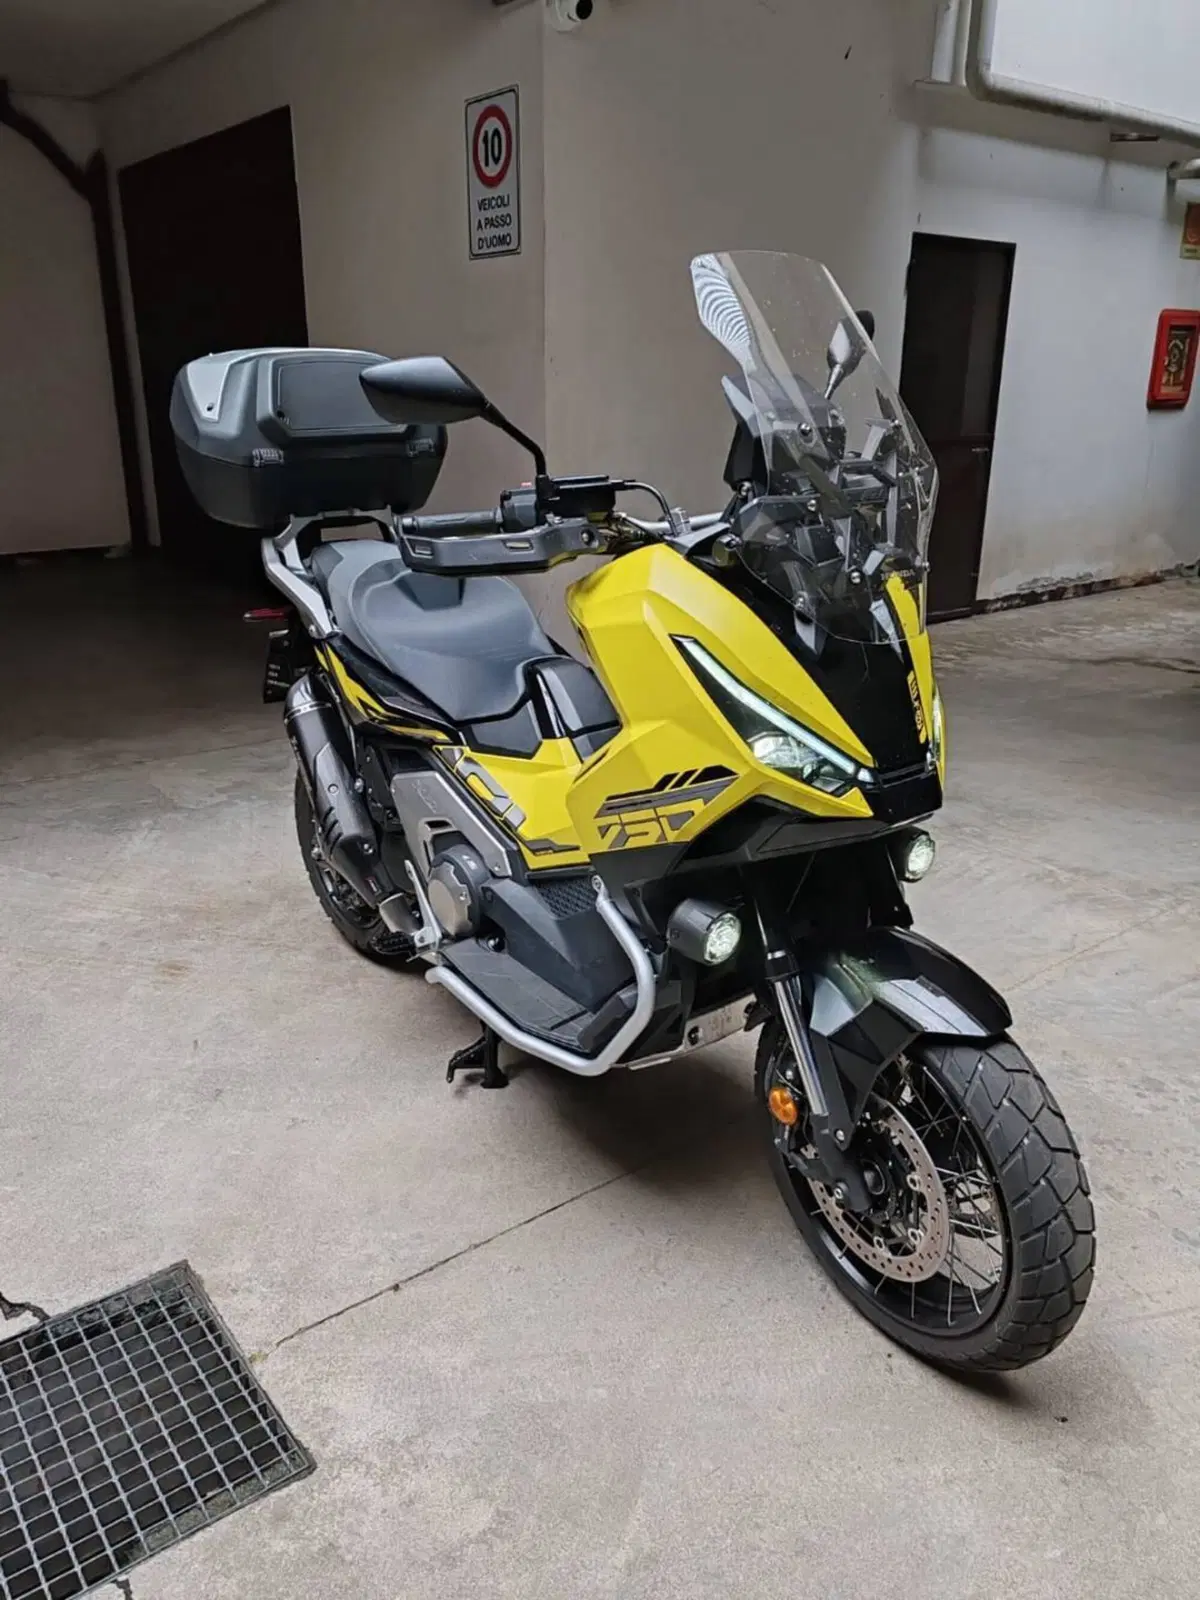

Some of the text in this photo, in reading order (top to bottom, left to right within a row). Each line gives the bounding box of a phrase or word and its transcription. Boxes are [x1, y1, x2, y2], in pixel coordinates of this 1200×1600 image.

[482, 127, 502, 167] 10
[477, 193, 510, 212] VEICOLI
[476, 213, 512, 232] A PASSO
[477, 233, 512, 250] D'UOMO
[880, 569, 916, 581] HNDA
